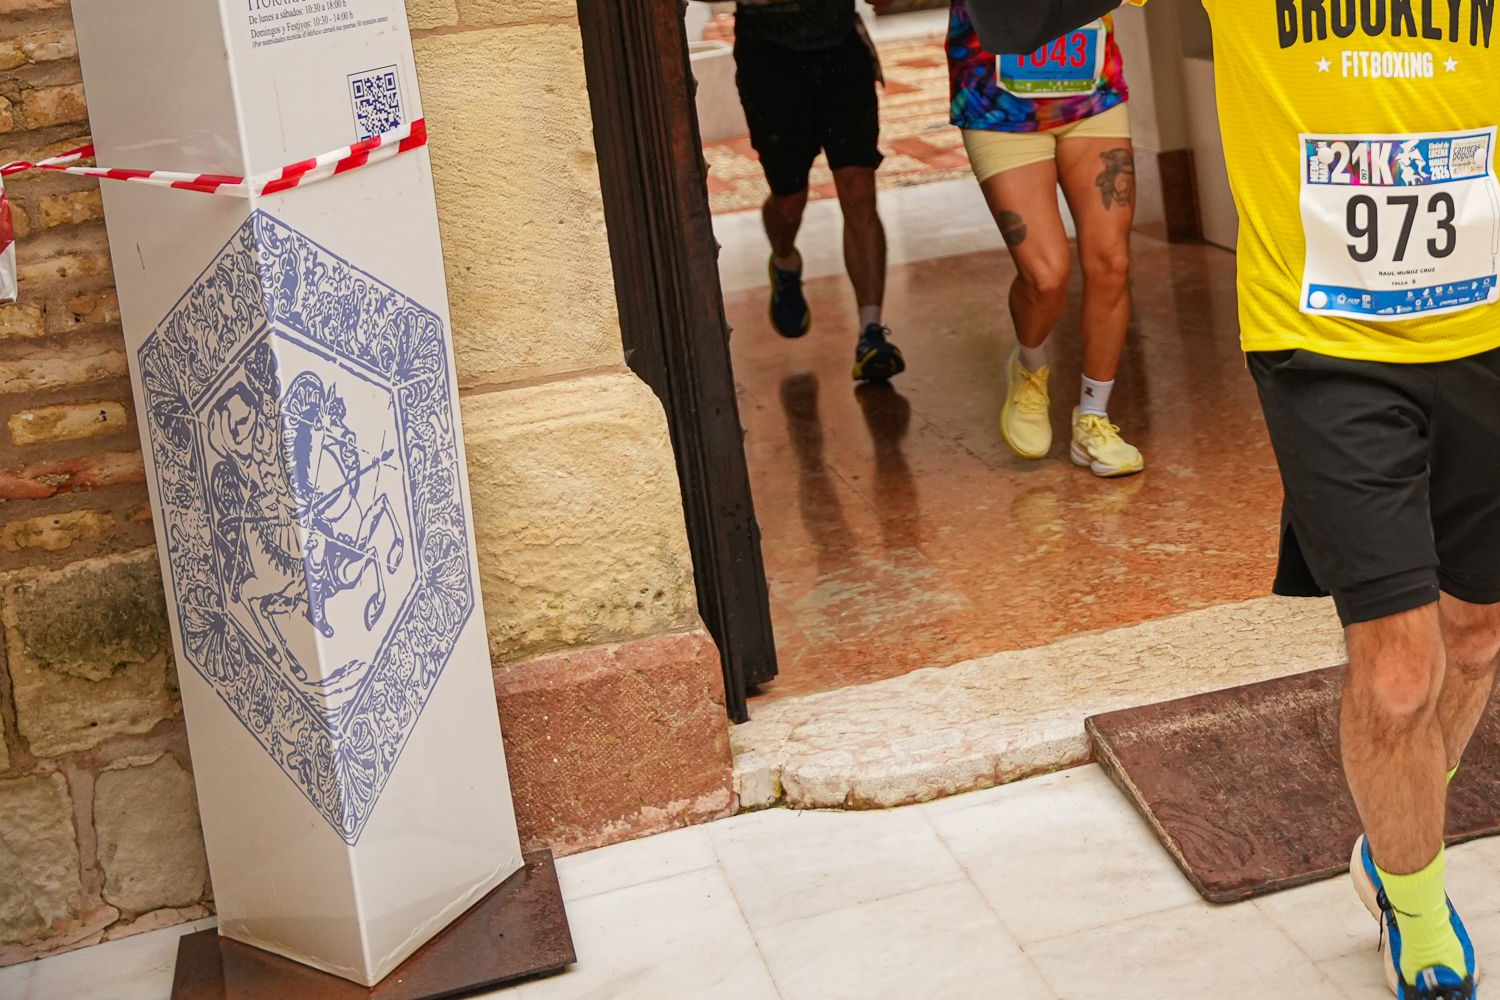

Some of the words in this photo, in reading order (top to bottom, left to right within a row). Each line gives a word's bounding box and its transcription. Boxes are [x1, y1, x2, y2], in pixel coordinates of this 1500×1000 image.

[250, 22, 281, 38] Domingos
[1341, 50, 1434, 79] FITBOXING
[1330, 141, 1394, 185] 21K
[1346, 192, 1457, 263] 973
